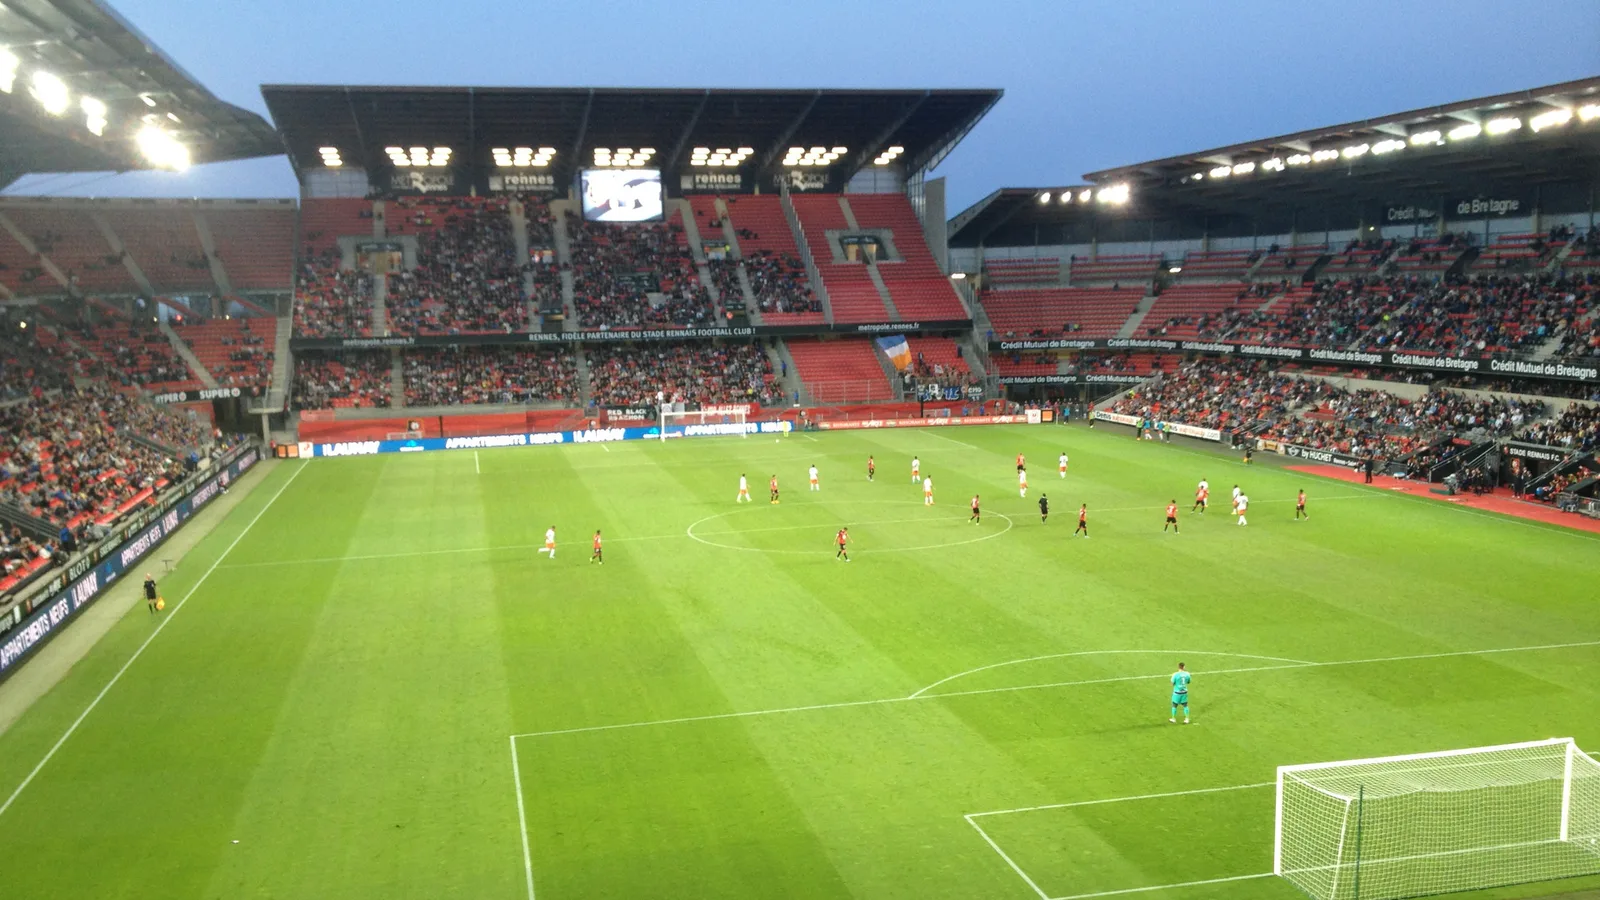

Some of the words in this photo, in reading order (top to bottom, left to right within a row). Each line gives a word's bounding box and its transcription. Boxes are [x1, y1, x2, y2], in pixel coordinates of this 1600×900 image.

[1458, 202, 1470, 214] de
[1472, 199, 1519, 215] Bretagne
[858, 322, 920, 332] metropole.rennes.fr
[529, 333, 560, 341] RENNES,
[587, 331, 629, 340] PARTENAIRE
[643, 330, 665, 338] STADE
[666, 329, 697, 337] RENNAIS
[698, 328, 732, 336] FOOTBALL
[734, 327, 751, 335] CLUB
[1024, 340, 1048, 348] Mutuel
[1050, 340, 1059, 348] de
[1060, 340, 1095, 350] Bretagne
[1107, 339, 1129, 347] Crédit
[1130, 339, 1150, 347] Mutuel
[1240, 344, 1255, 353] Crédit
[1310, 348, 1327, 358] Crédit
[1327, 350, 1346, 360] Mutuel
[1346, 351, 1354, 360] de
[1354, 351, 1382, 364] Bretagne
[1391, 353, 1412, 364] Crédit
[1412, 355, 1435, 367] Mutuel
[1436, 357, 1445, 367] de
[1445, 357, 1478, 371] Bretagne
[1491, 359, 1515, 372] Crédit
[1516, 361, 1543, 374] Mutuel
[1545, 364, 1556, 375] de
[1556, 364, 1597, 380] Bretagne
[1046, 375, 1077, 383] Bretagne
[200, 388, 230, 399] SUPER
[1302, 449, 1309, 459] by
[1309, 450, 1332, 462] HUCHET
[1510, 448, 1526, 457] STADE
[1527, 450, 1550, 460] RENNAIS
[1551, 454, 1560, 462] F.C.
[0, 614, 50, 669] APPARTEMENTS
[49, 598, 69, 626] NEUFS
